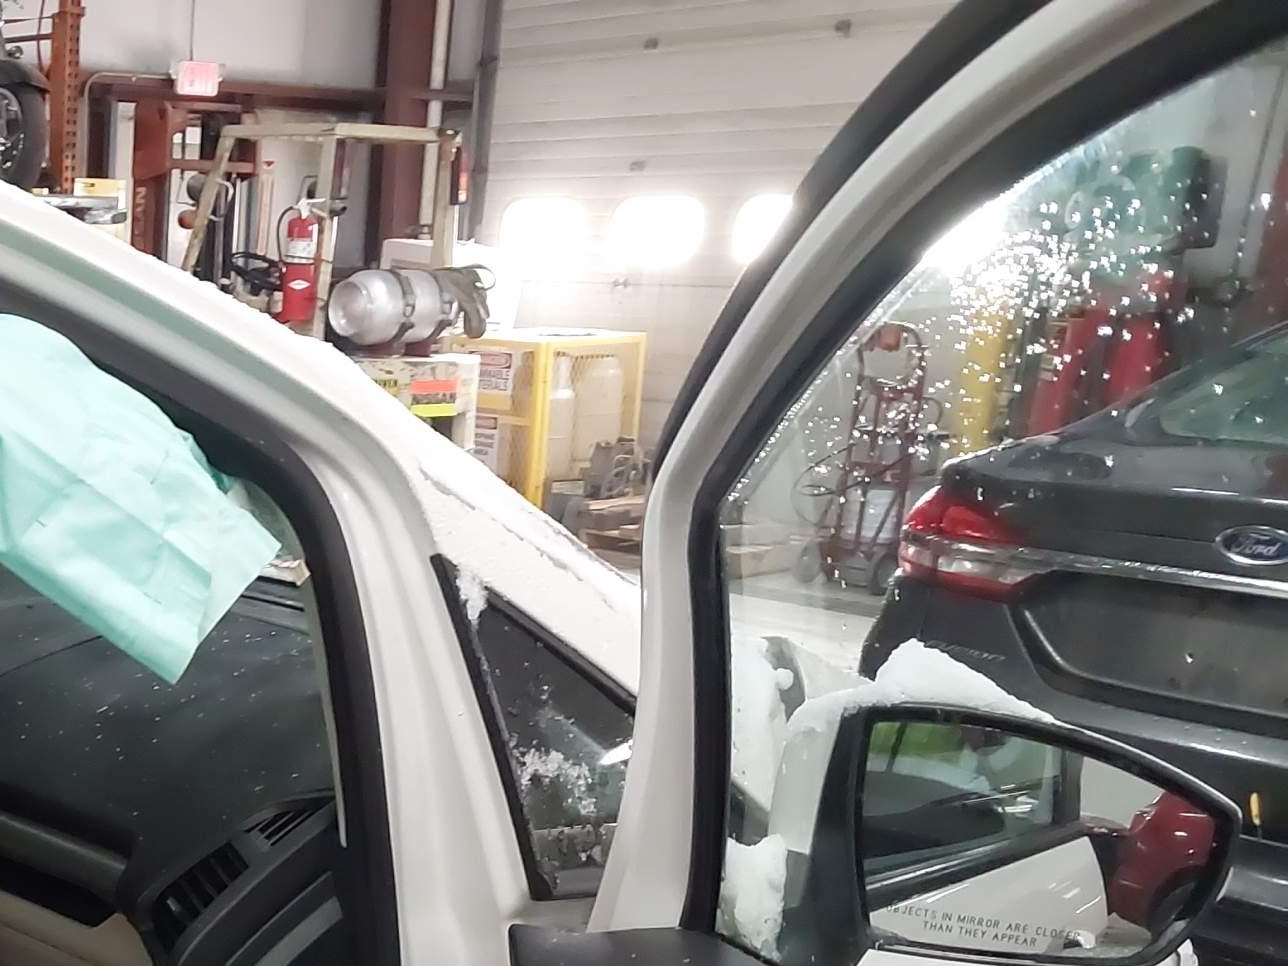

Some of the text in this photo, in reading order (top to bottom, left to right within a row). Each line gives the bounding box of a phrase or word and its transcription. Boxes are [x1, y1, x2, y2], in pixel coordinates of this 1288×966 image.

[1231, 532, 1281, 556] Ford
[886, 904, 938, 920] OBJECTS
[941, 911, 953, 922] IN
[956, 913, 1001, 930] MIRROR
[1005, 922, 1030, 934] ARE
[923, 920, 1038, 947] THAN THEY APPEAR
